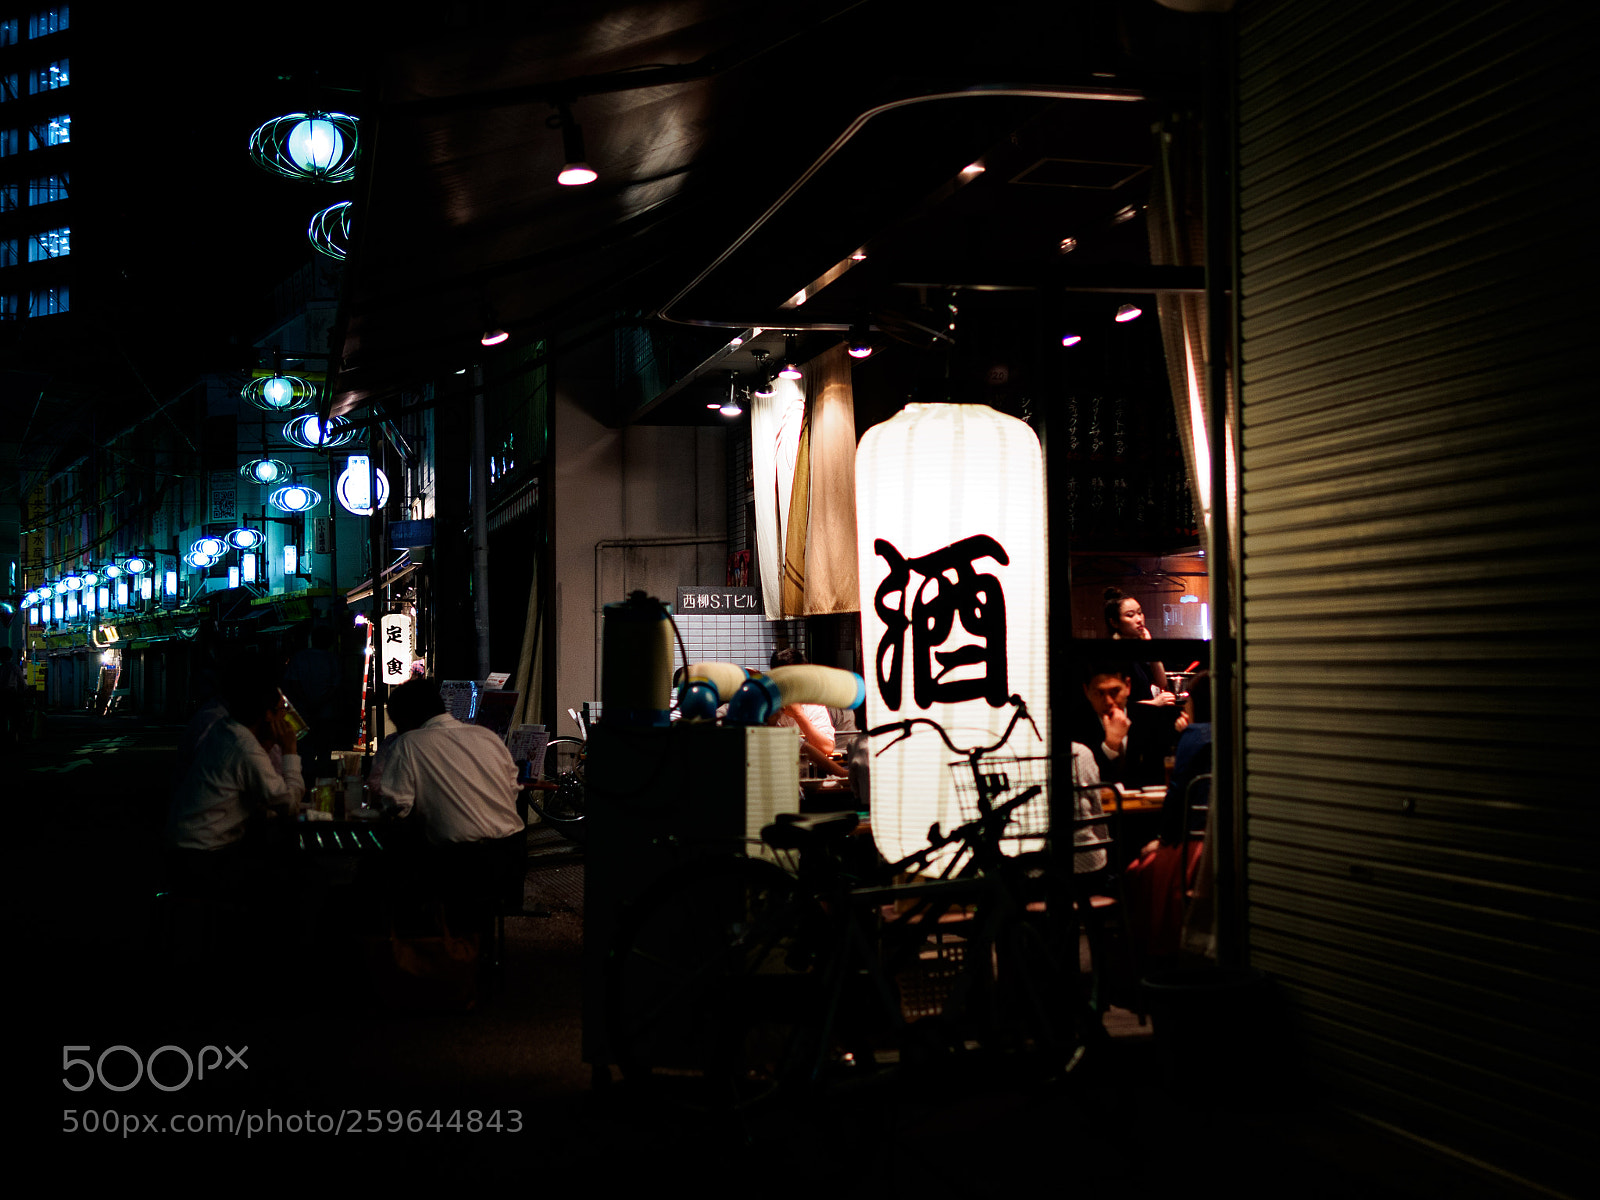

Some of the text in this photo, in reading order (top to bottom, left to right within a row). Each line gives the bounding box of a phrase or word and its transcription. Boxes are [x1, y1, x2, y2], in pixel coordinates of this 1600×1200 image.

[682, 593, 758, 610] 西柳S.Tビル
[874, 534, 1010, 711] 酒
[386, 625, 404, 676] 定食
